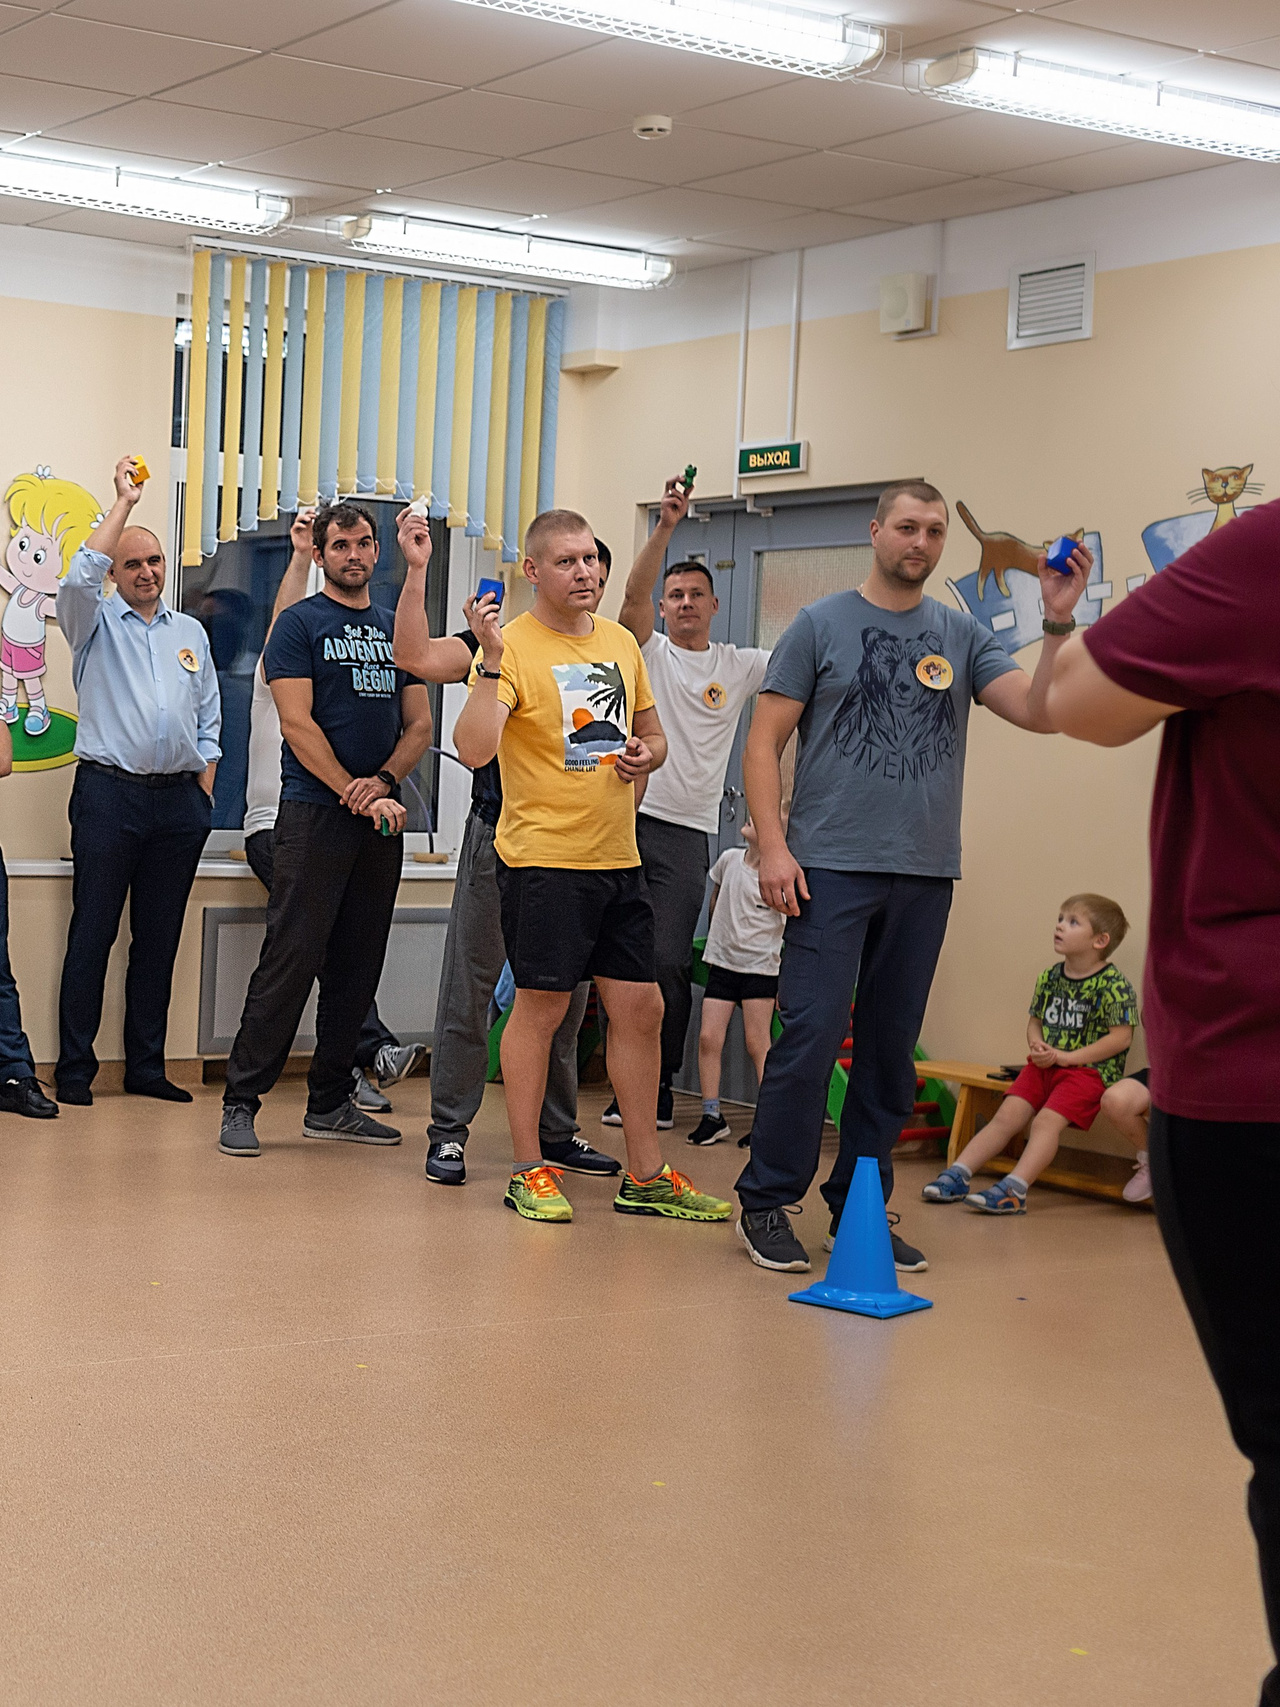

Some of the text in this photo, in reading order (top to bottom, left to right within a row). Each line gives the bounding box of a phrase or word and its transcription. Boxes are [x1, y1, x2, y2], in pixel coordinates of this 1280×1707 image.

[749, 450, 790, 467] ВЫХОД
[323, 637, 394, 662] ADVENTU
[352, 668, 396, 693] BEGIN
[579, 758, 599, 766] FEELING
[1045, 1007, 1084, 1028] GAME
